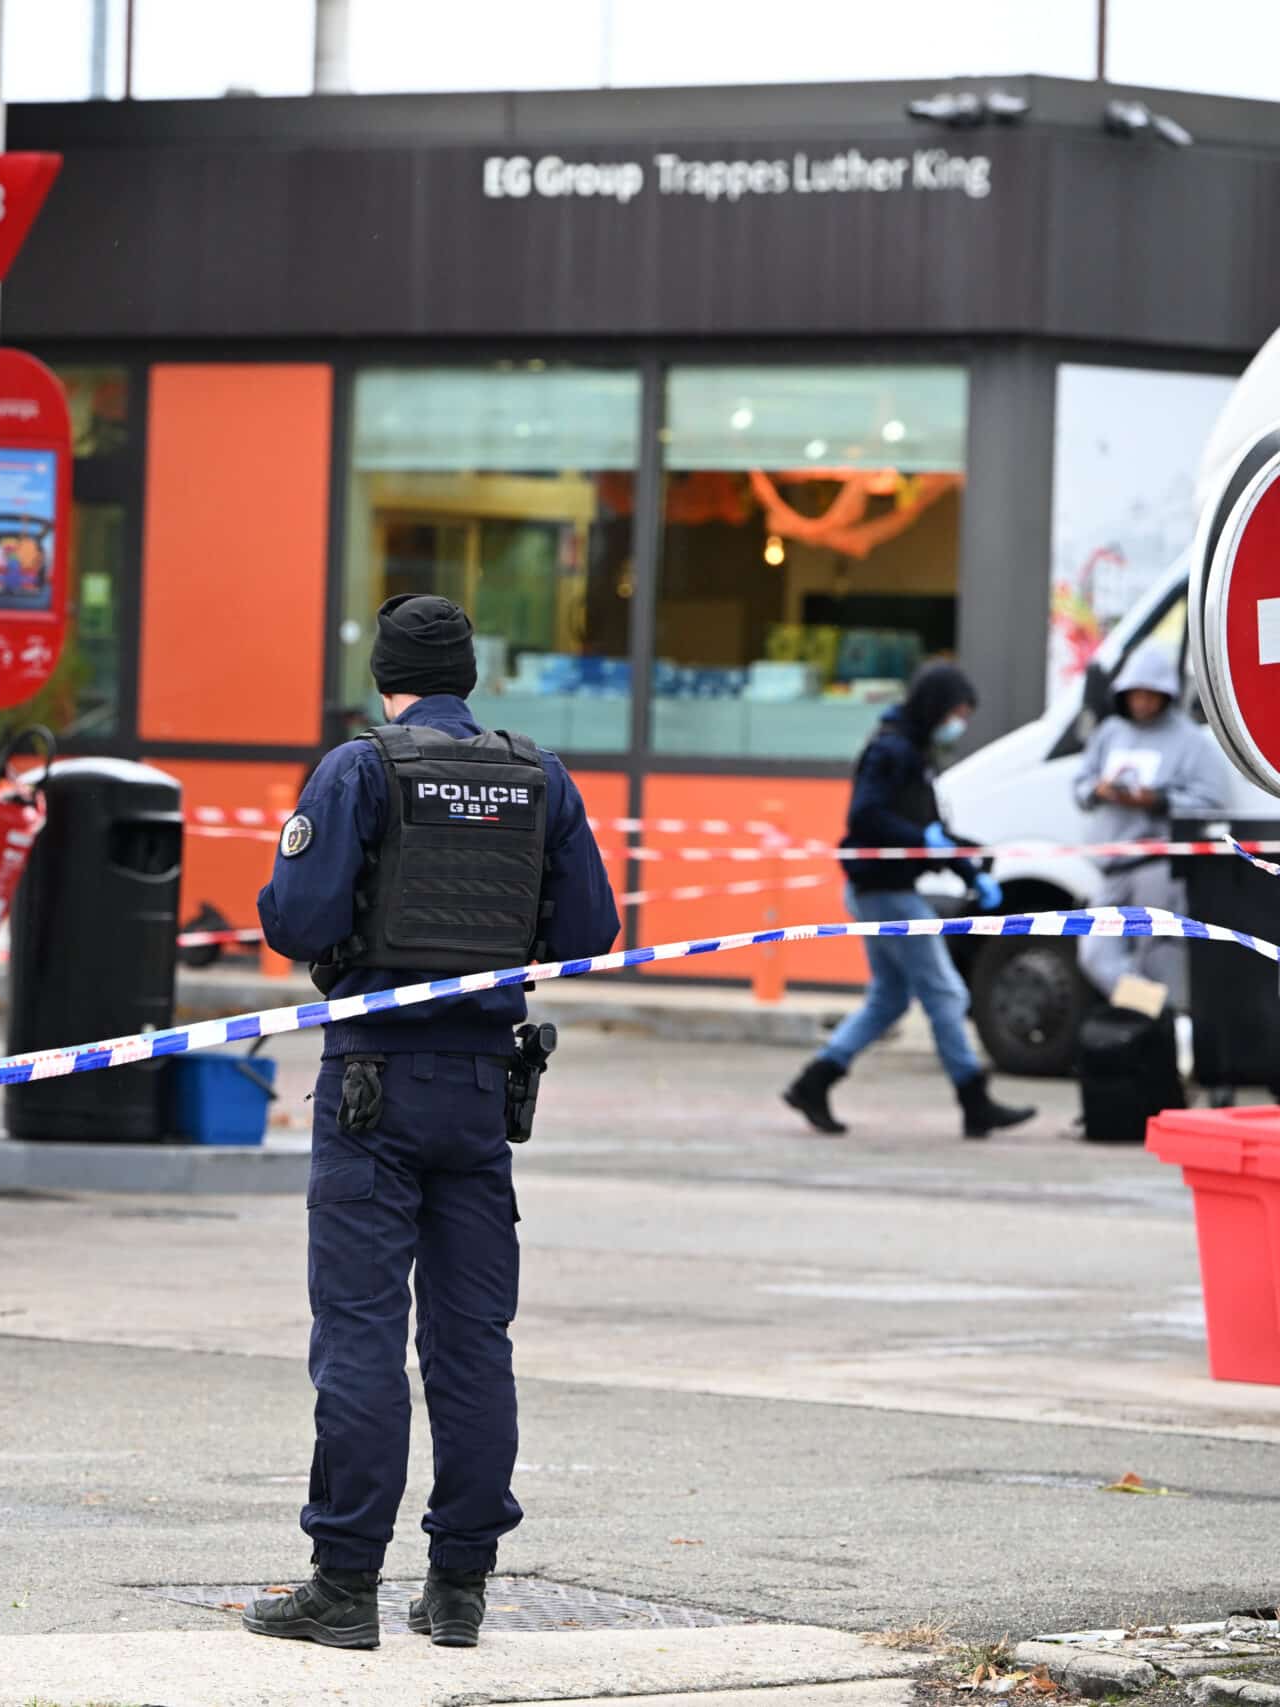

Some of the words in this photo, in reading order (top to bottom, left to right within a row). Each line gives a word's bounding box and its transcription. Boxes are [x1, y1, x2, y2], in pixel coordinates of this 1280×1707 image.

[483, 157, 531, 198] EG
[534, 155, 643, 202] Group
[654, 153, 790, 202] Trappes
[793, 149, 909, 193] Luther
[913, 147, 992, 199] King
[417, 783, 529, 805] POLICE
